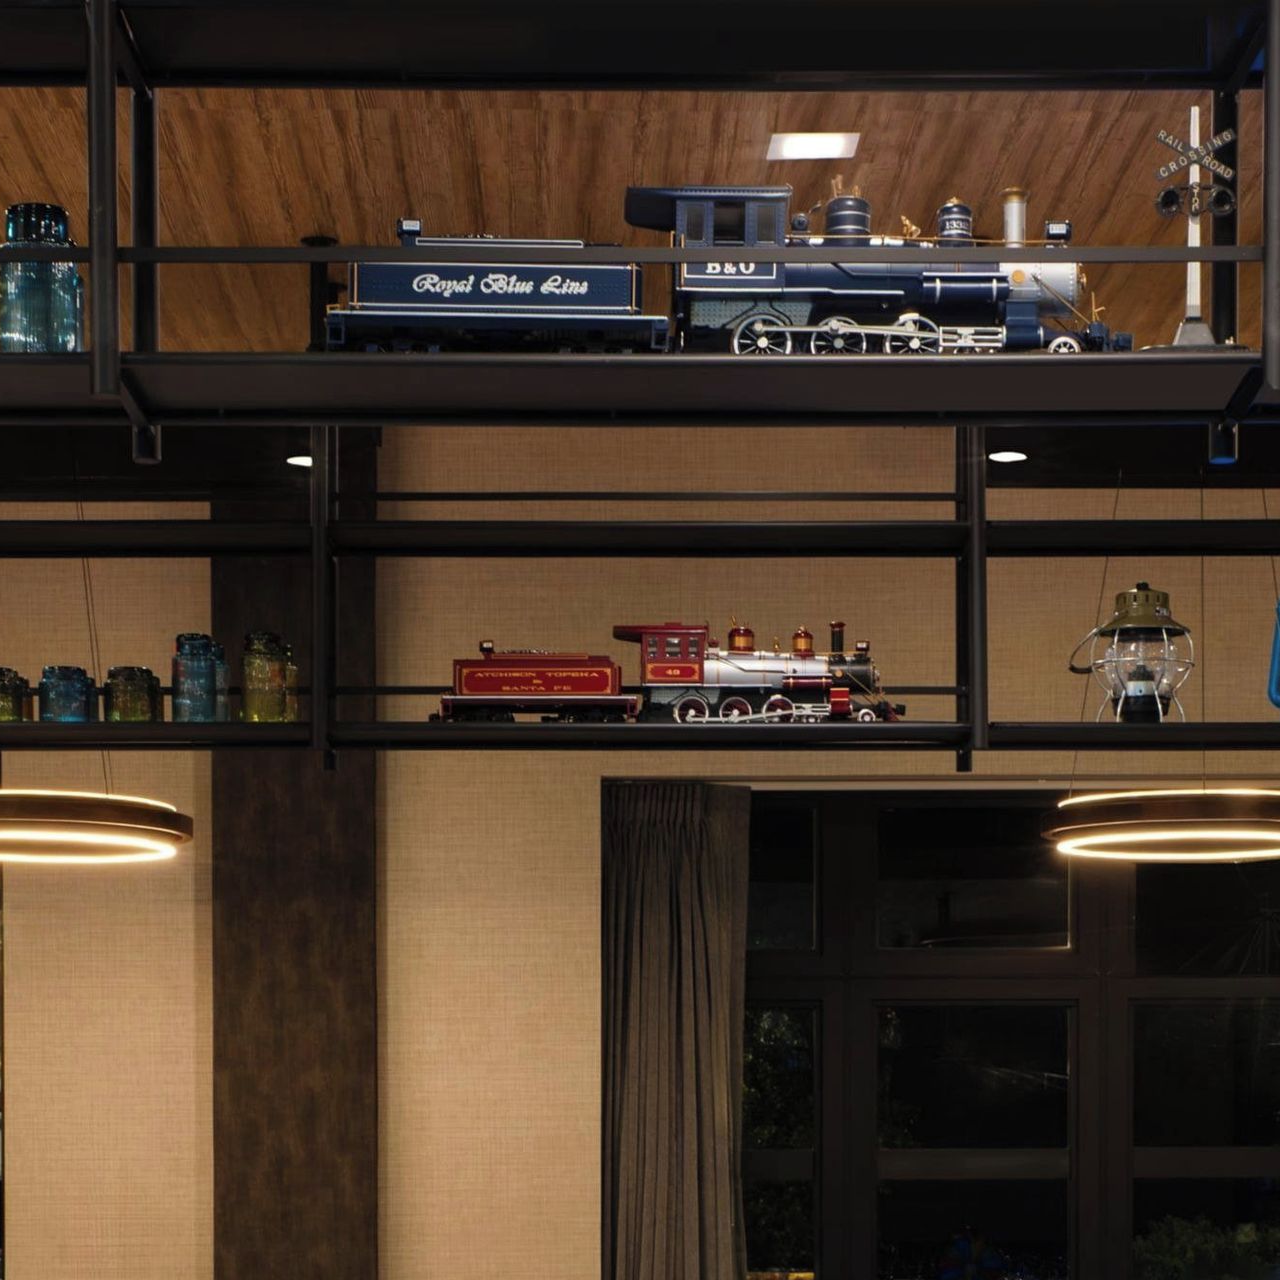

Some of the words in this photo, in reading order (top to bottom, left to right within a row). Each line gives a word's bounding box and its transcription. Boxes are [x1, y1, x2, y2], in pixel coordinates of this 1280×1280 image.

[412, 273, 475, 297] Royal
[480, 273, 534, 294] Blue
[540, 275, 588, 295] Line
